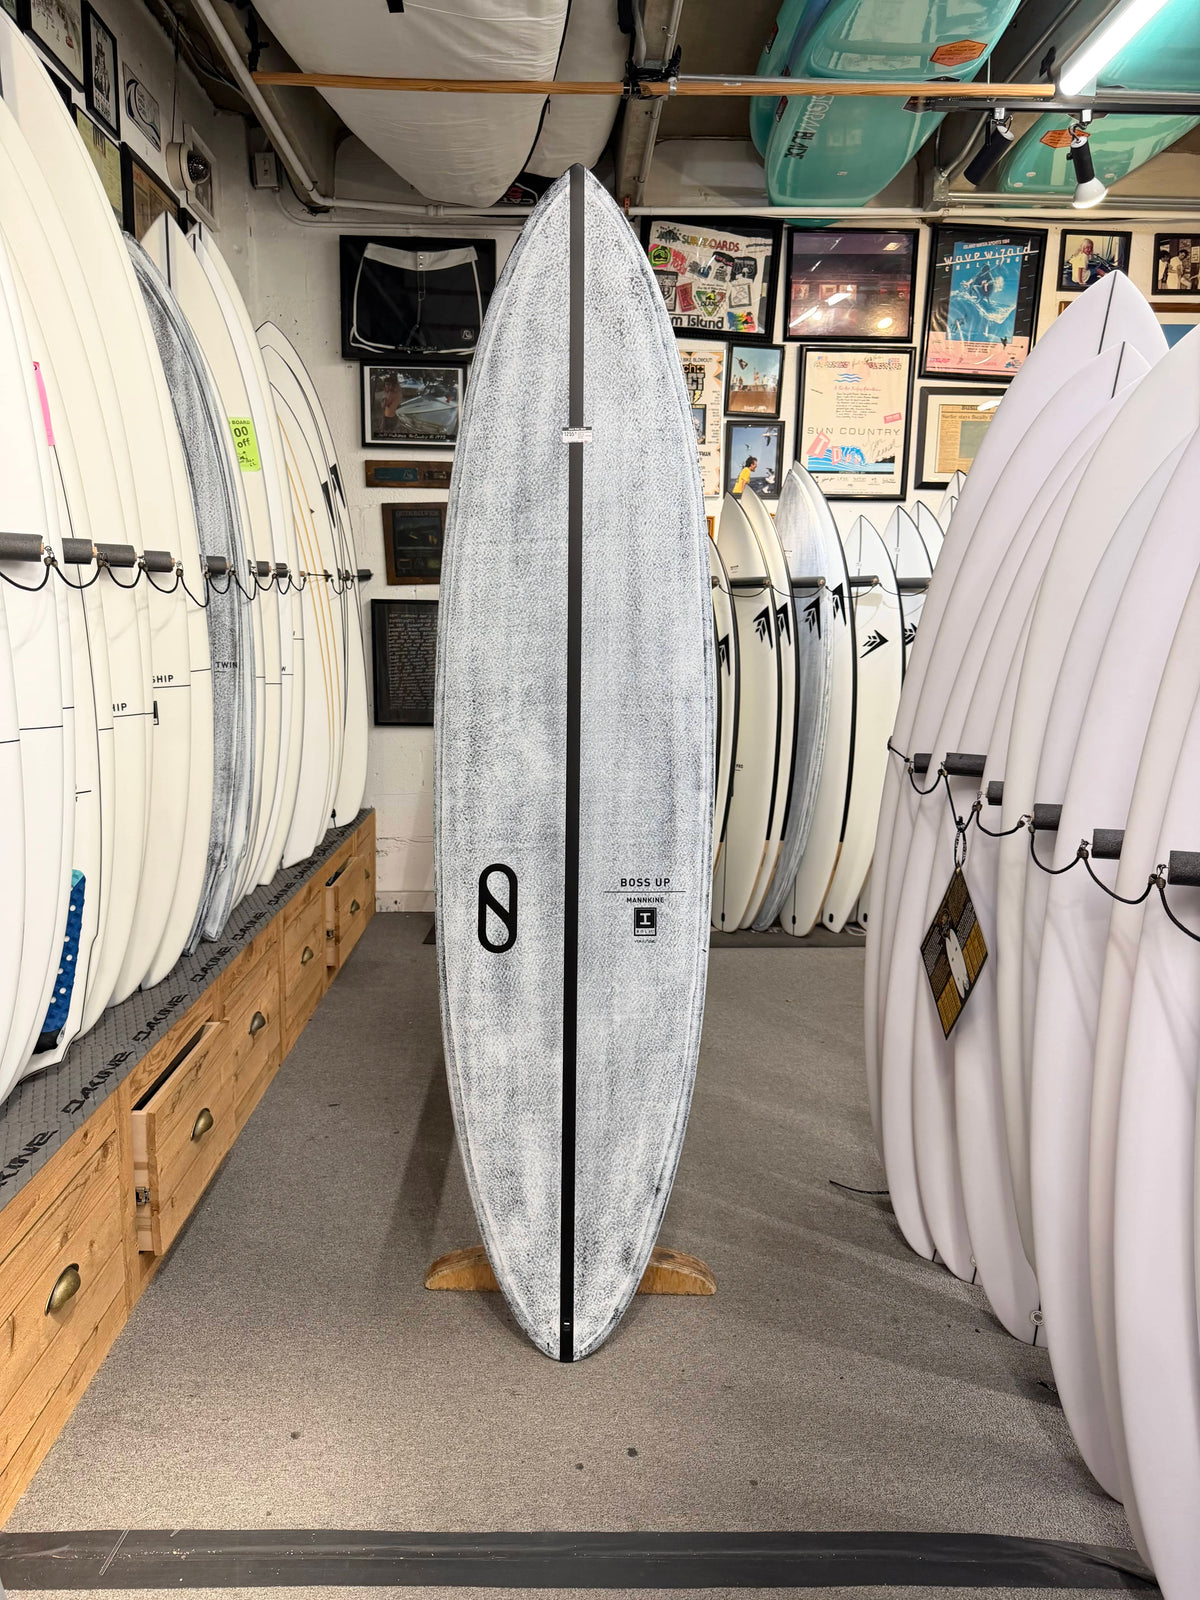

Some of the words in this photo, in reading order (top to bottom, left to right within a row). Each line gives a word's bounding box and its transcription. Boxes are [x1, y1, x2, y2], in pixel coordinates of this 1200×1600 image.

[943, 252, 980, 265] wave
[984, 236, 1031, 267] wizard
[687, 315, 724, 329] Island
[233, 426, 249, 438] 00
[807, 427, 834, 435] SUN
[839, 428, 901, 436] COUNTRY
[237, 438, 250, 448] off
[215, 661, 238, 669] TWIN
[620, 877, 651, 887] BOSS
[655, 877, 671, 887] UP
[190, 945, 235, 983] DAKINE
[131, 993, 189, 1042] DAKINE
[61, 1050, 135, 1115] DAKINE
